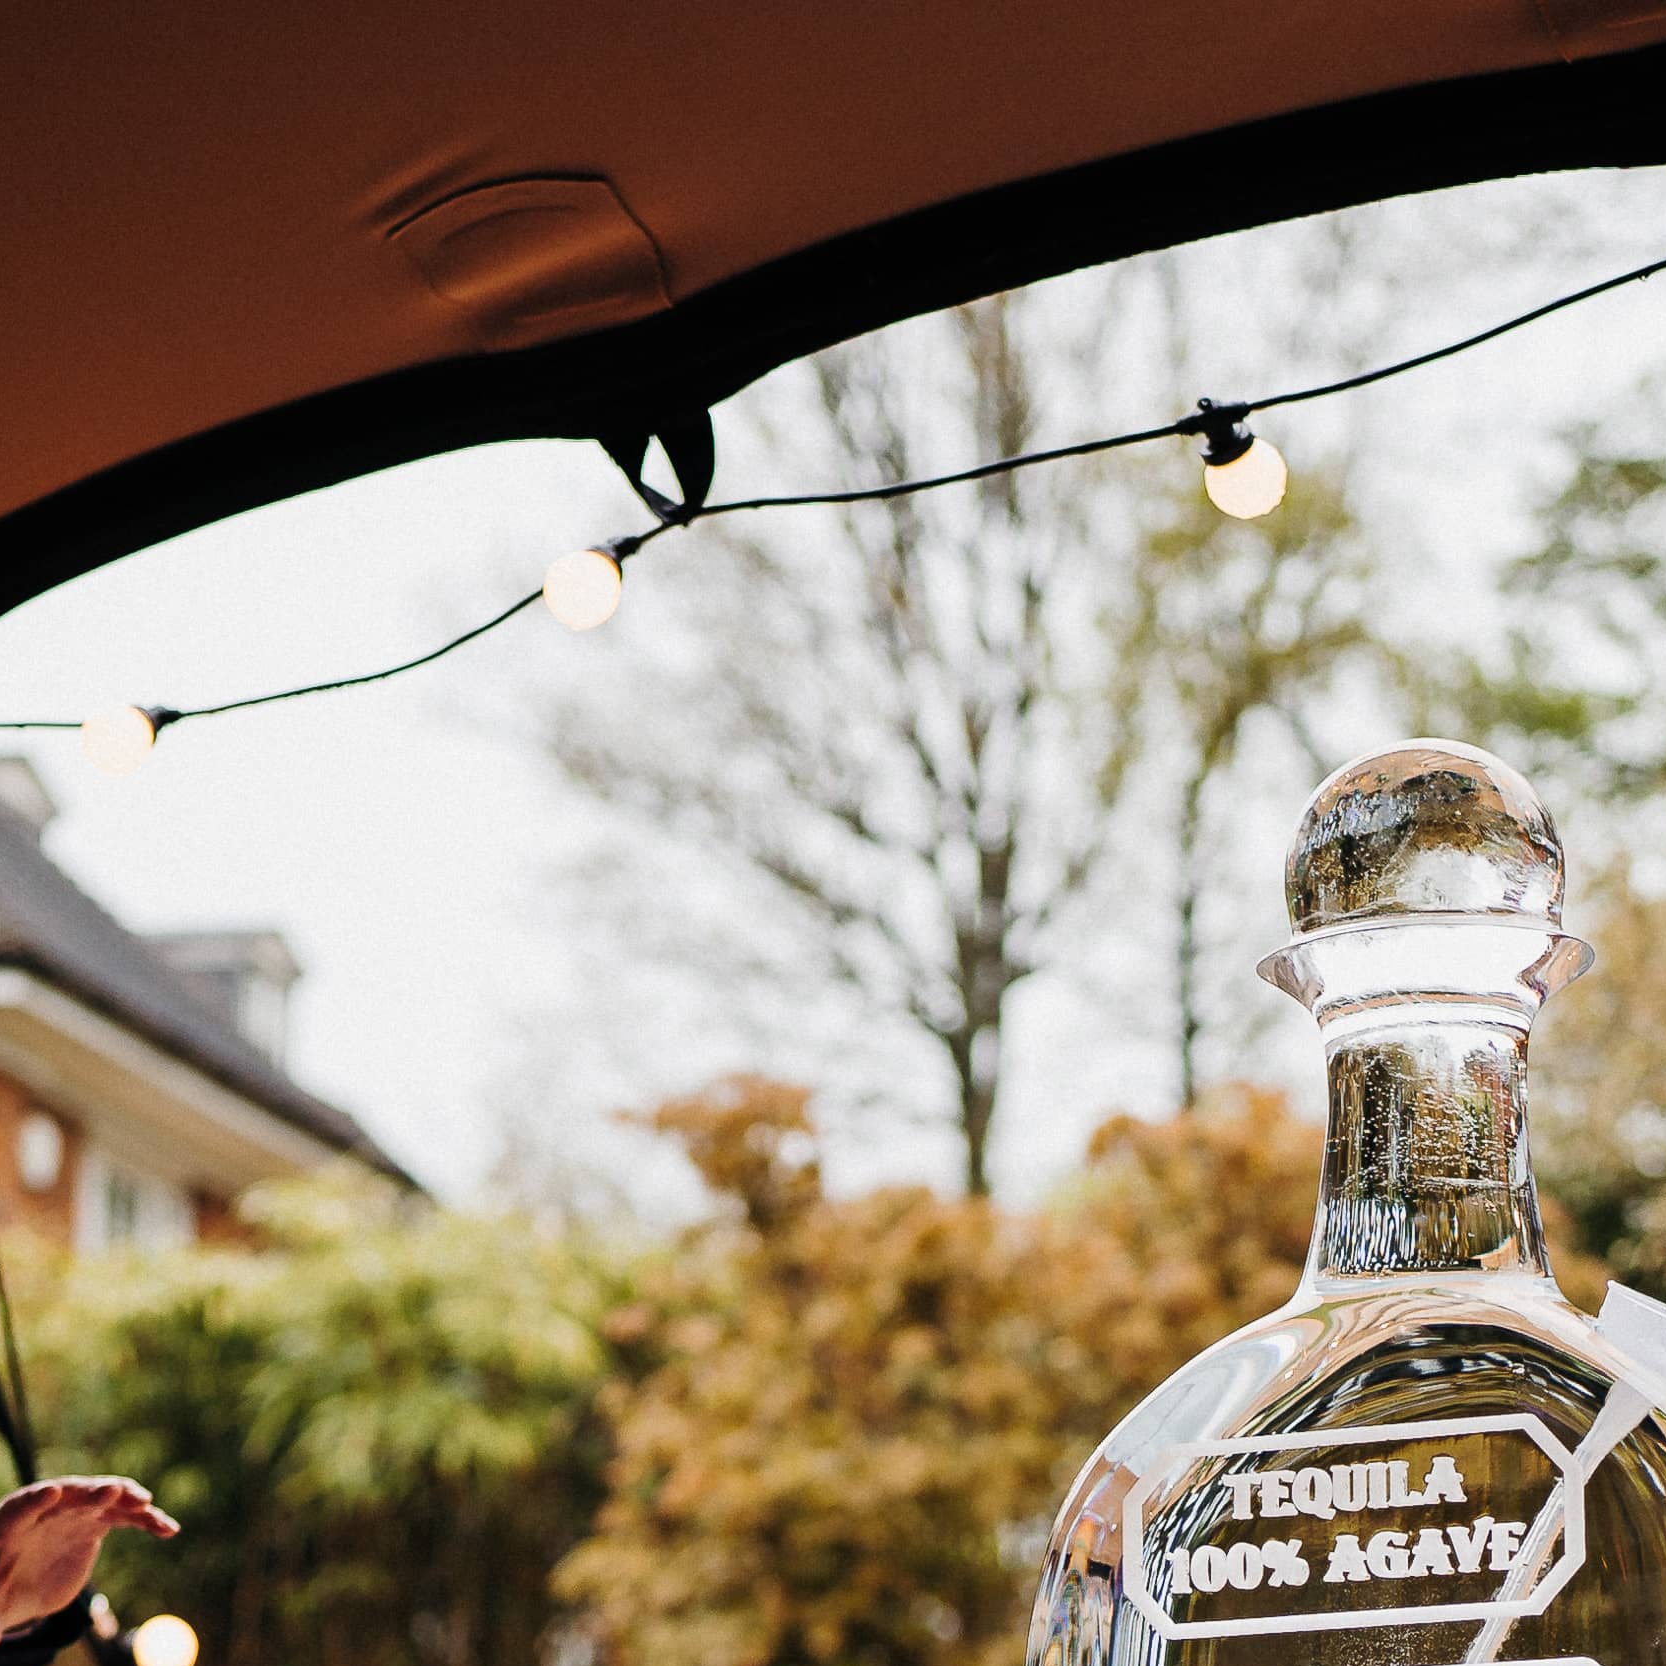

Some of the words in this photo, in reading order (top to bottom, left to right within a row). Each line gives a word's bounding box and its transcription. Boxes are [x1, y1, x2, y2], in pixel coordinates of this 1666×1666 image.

[1221, 1455, 1469, 1522] TEQUILA
[1165, 1538, 1311, 1595] 100%
[1323, 1515, 1529, 1583] AGAVE
